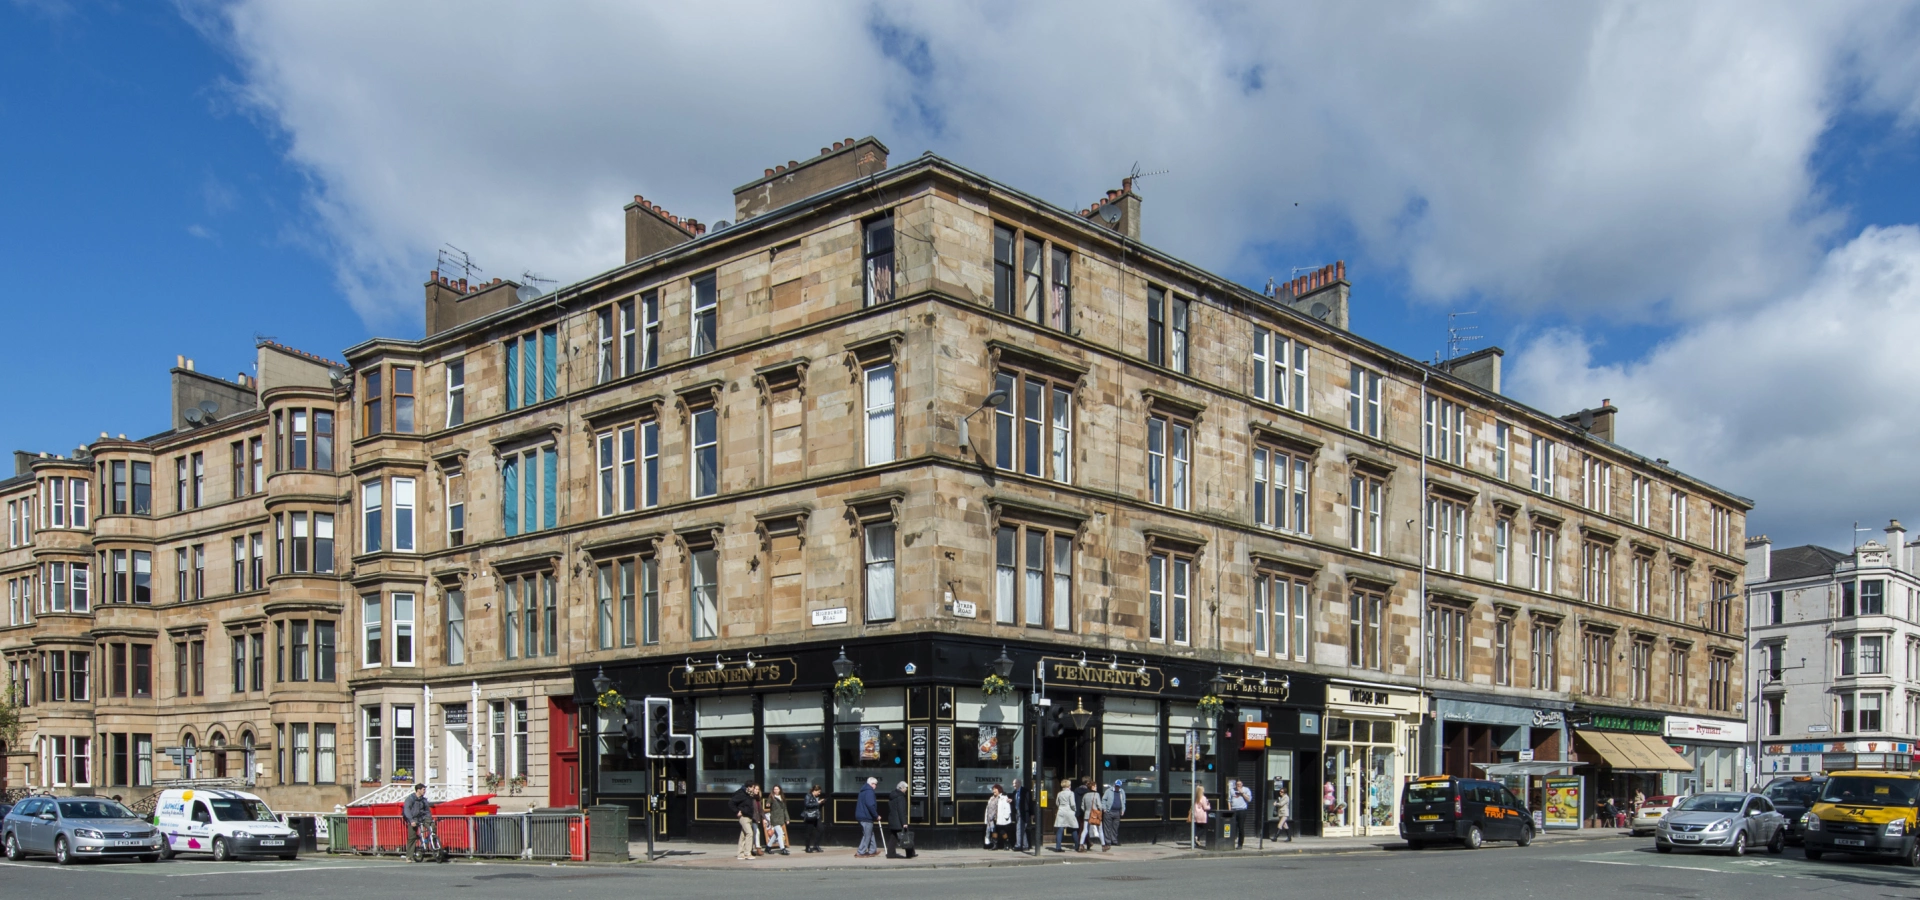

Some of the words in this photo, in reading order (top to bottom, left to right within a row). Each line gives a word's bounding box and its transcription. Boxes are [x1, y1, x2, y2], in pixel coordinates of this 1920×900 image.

[682, 665, 781, 686] TENNENT'S
[1054, 664, 1151, 687] TENNENT'S
[1226, 683, 1238, 691] HE
[1242, 684, 1284, 695] BASEMENT
[1350, 688, 1373, 705] vintage
[1374, 691, 1389, 705] guru
[1696, 724, 1721, 735] Ryman
[974, 776, 1003, 784] TENNENT'S
[1485, 811, 1505, 819] TAXI
